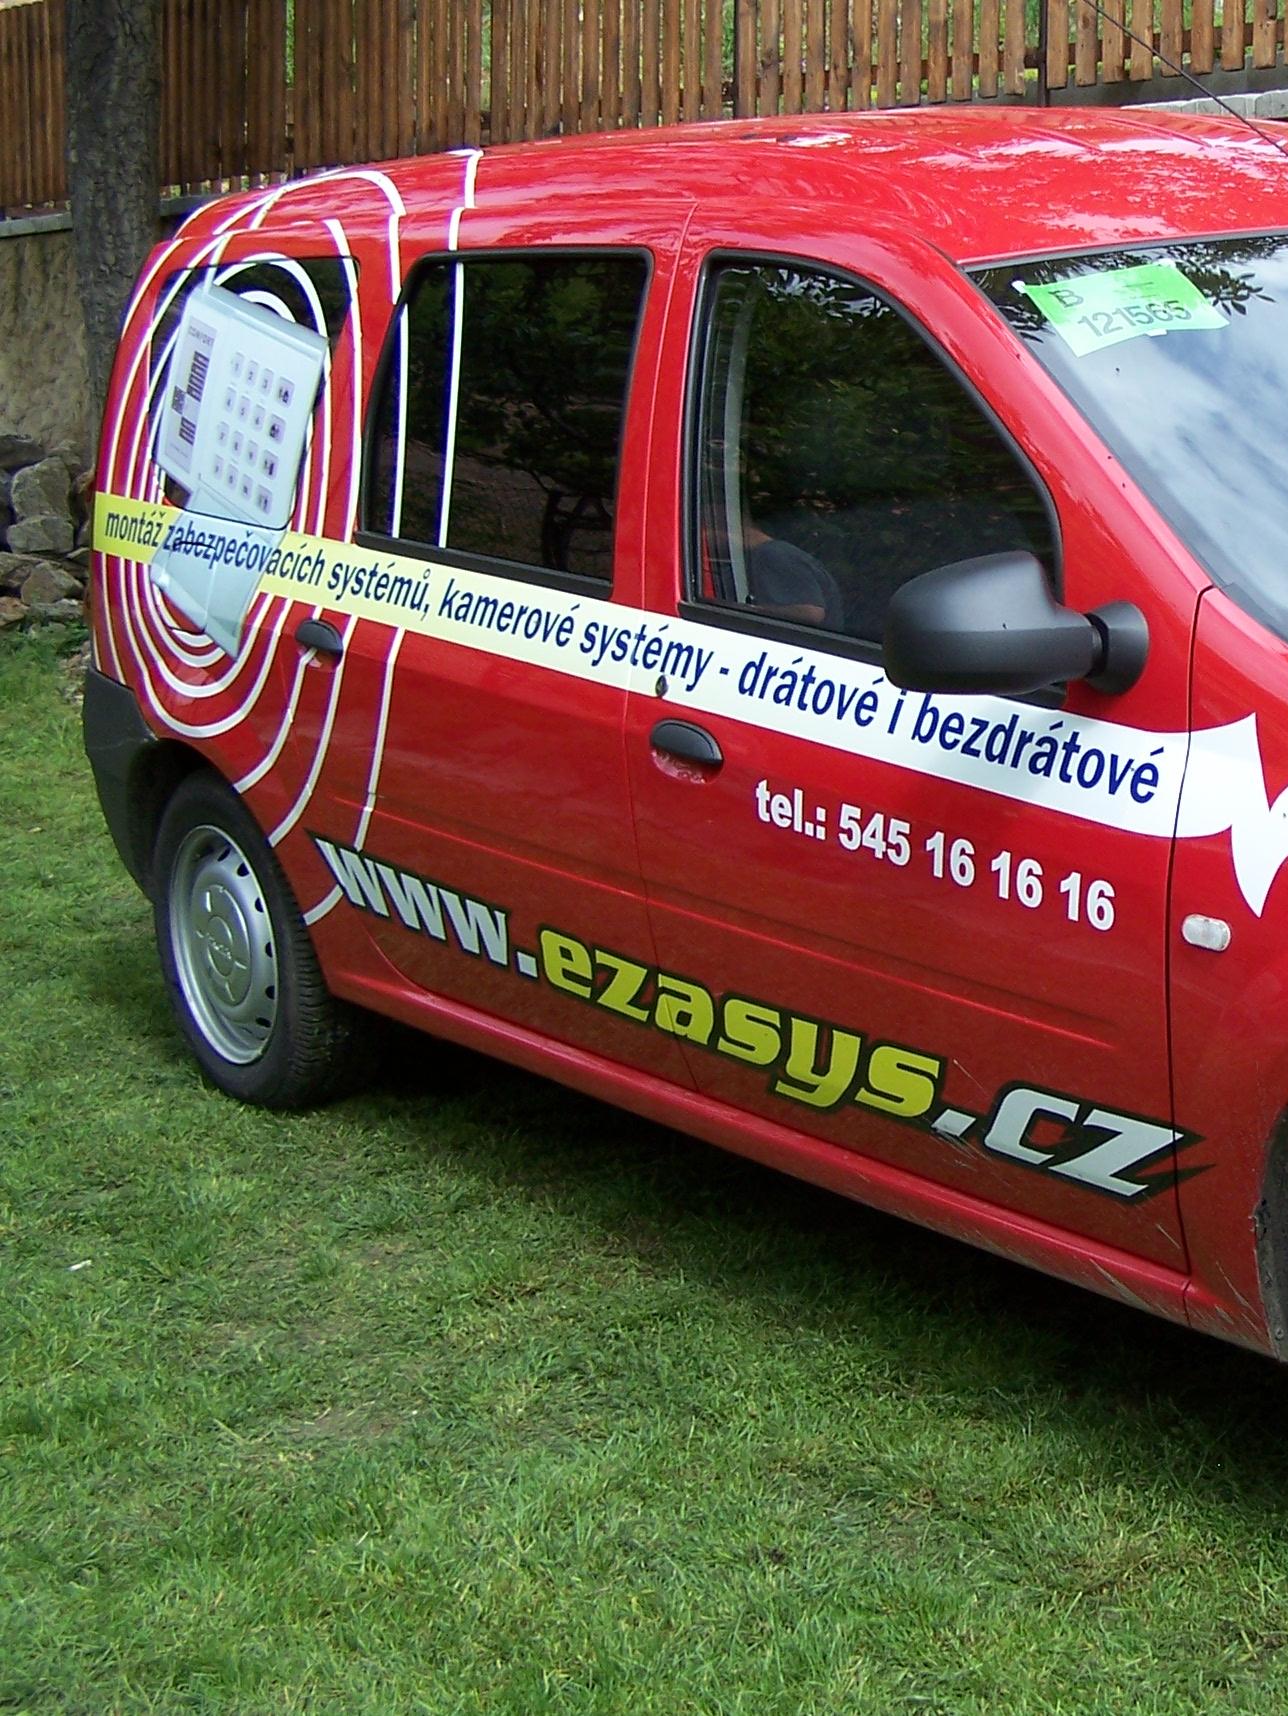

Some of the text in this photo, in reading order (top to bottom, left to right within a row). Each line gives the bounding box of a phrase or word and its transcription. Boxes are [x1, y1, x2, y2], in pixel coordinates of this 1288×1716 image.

[1048, 288, 1083, 308] B
[1077, 300, 1192, 337] 121565
[105, 508, 163, 551] montáž
[164, 523, 325, 586] zabezpečovacích
[327, 560, 430, 621] systémů,
[439, 579, 580, 647] kamerové
[580, 619, 714, 692] systémy
[738, 651, 885, 727] drátové
[888, 689, 905, 735] i
[911, 693, 1165, 804] bezdrátové
[756, 779, 1115, 931] tel.: 545 16 16 16
[315, 838, 1184, 1197] www.ezasys.cz
